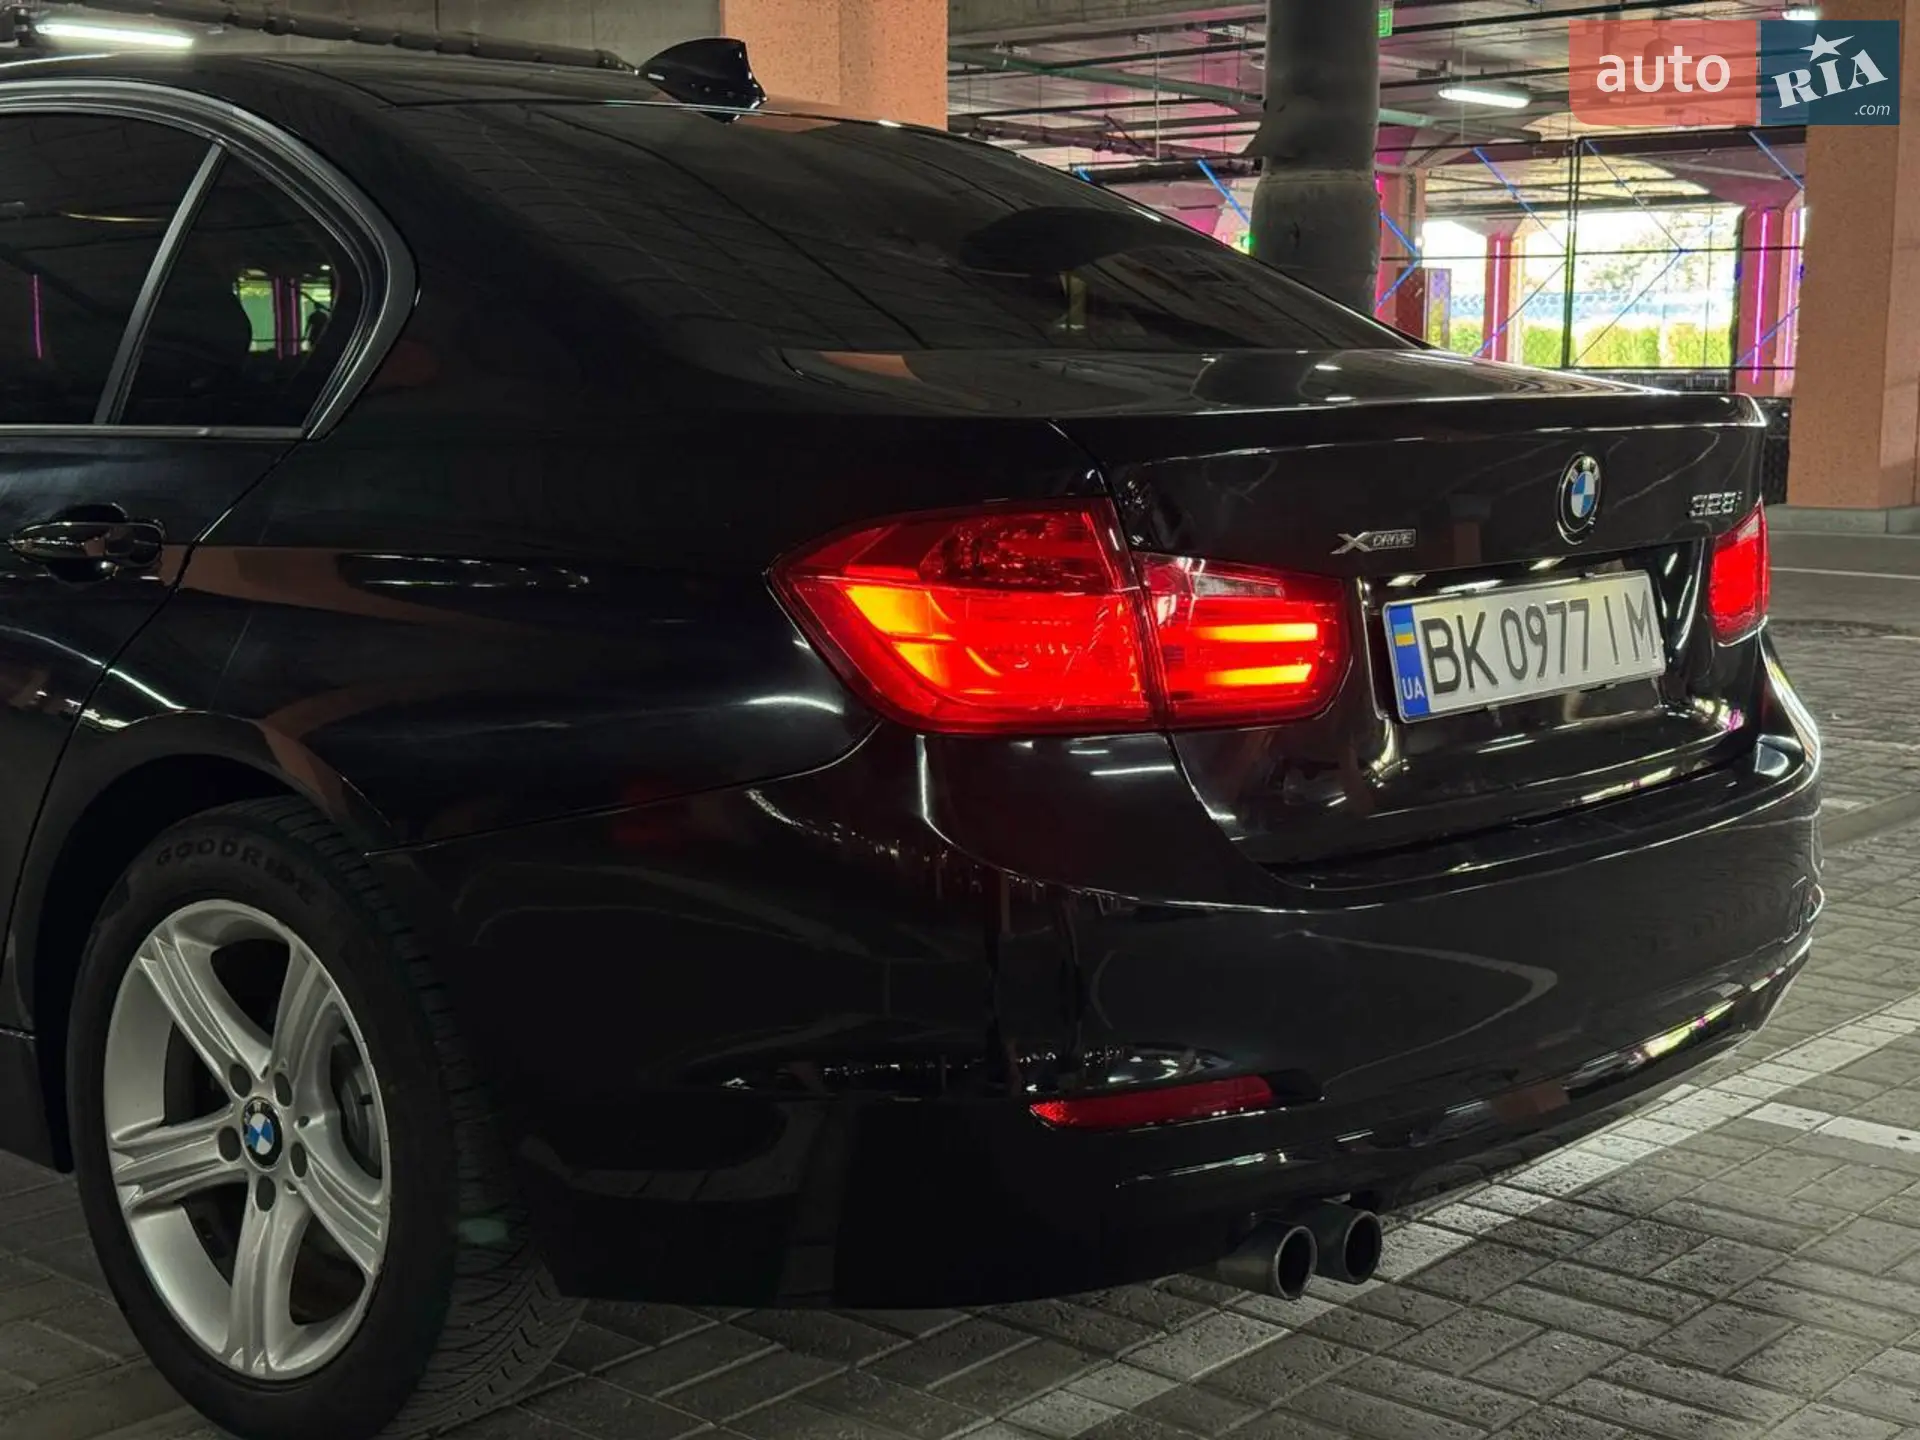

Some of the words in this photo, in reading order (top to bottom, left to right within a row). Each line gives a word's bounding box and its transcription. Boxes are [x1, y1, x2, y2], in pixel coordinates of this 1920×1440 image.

[1420, 612, 1499, 694] BK
[1500, 598, 1589, 681] 0977
[1402, 676, 1425, 701] UA
